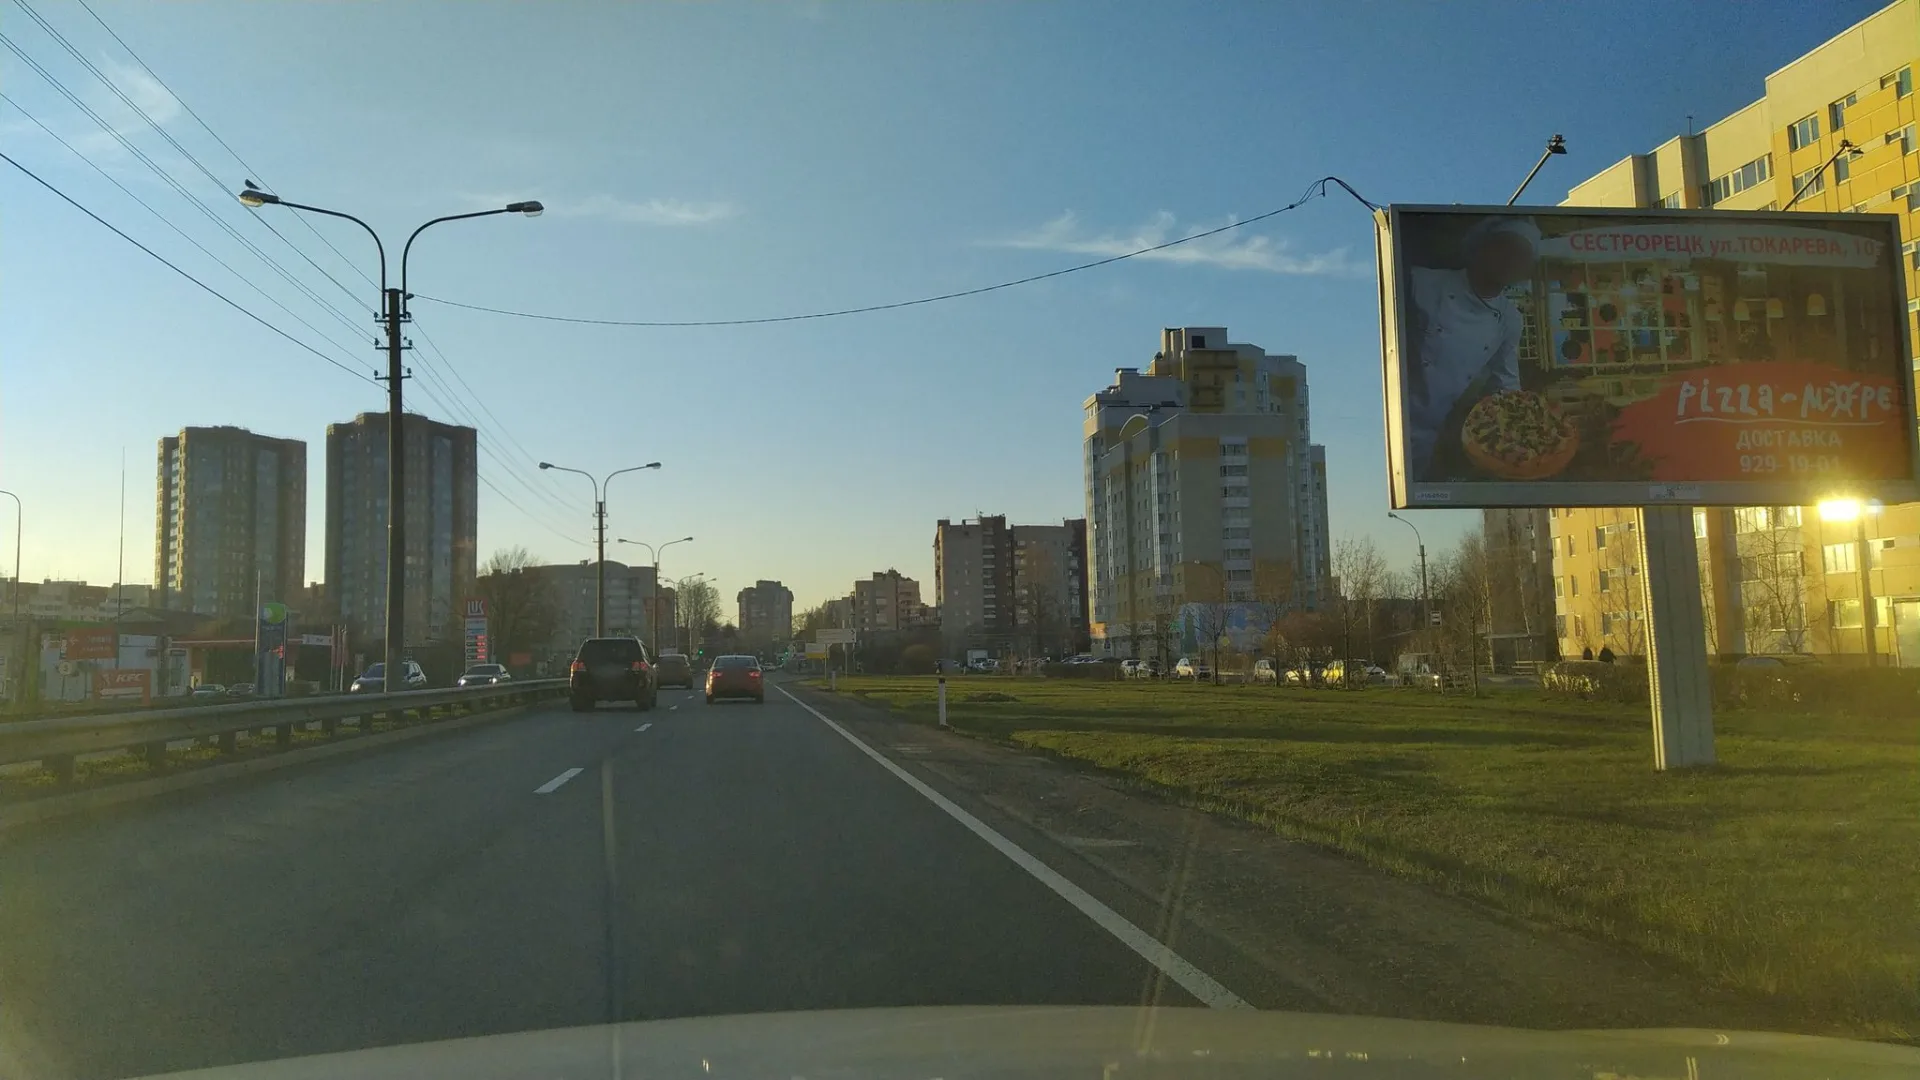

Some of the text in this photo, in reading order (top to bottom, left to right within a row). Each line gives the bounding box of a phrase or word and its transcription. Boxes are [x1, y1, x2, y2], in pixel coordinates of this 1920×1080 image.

[1570, 233, 1704, 256] СЕСТРОРЕЦК
[1736, 430, 1842, 450] ДОСТАВКА
[116, 673, 144, 683] KFC
